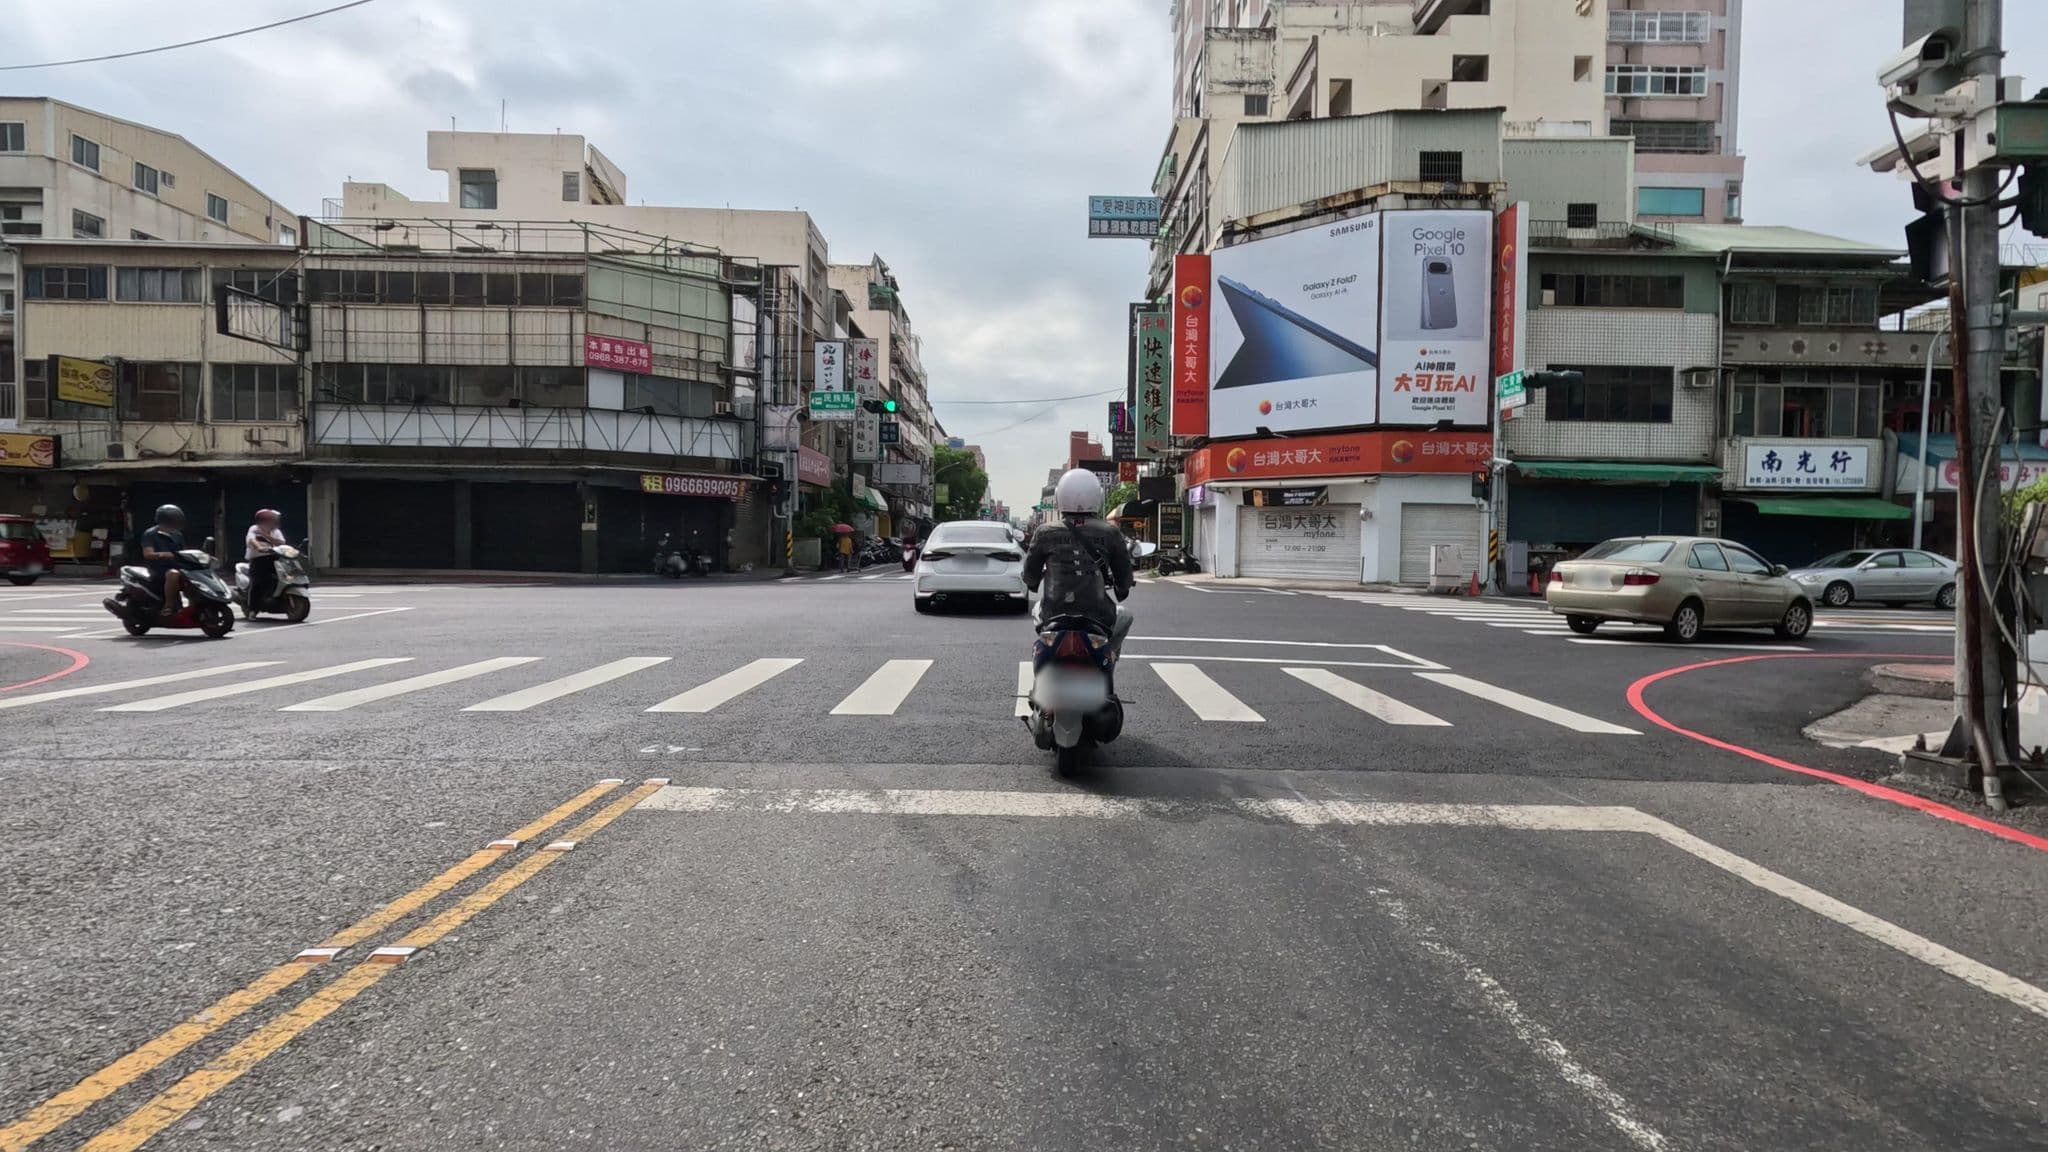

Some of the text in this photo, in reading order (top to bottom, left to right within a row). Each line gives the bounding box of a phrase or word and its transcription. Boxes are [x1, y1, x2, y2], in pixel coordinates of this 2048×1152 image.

[1329, 219, 1374, 237] SAMSUNG
[1412, 227, 1465, 244] Google
[1414, 242, 1465, 256] Pixel 10
[1302, 274, 1358, 293] Galaxy Z Fold7
[588, 340, 649, 358] 本廣告出租
[1184, 315, 1199, 383] 台灣大哥大
[588, 351, 649, 368] 0968-387-676
[1414, 361, 1456, 372] AI神展開
[1144, 336, 1164, 436] 快速維修
[1393, 373, 1476, 393] 大可玩AI
[823, 393, 851, 403] 民族路
[1275, 398, 1318, 411] 台灣大哥大
[1421, 441, 1493, 456] 台灣大哥大
[1253, 449, 1322, 467] 台灣大哥大
[1761, 449, 1852, 473] 南光行
[643, 474, 664, 492] 租
[665, 476, 739, 496] 0966699005
[1265, 513, 1337, 530] 台灣大哥大
[1303, 530, 1336, 540] myfone
